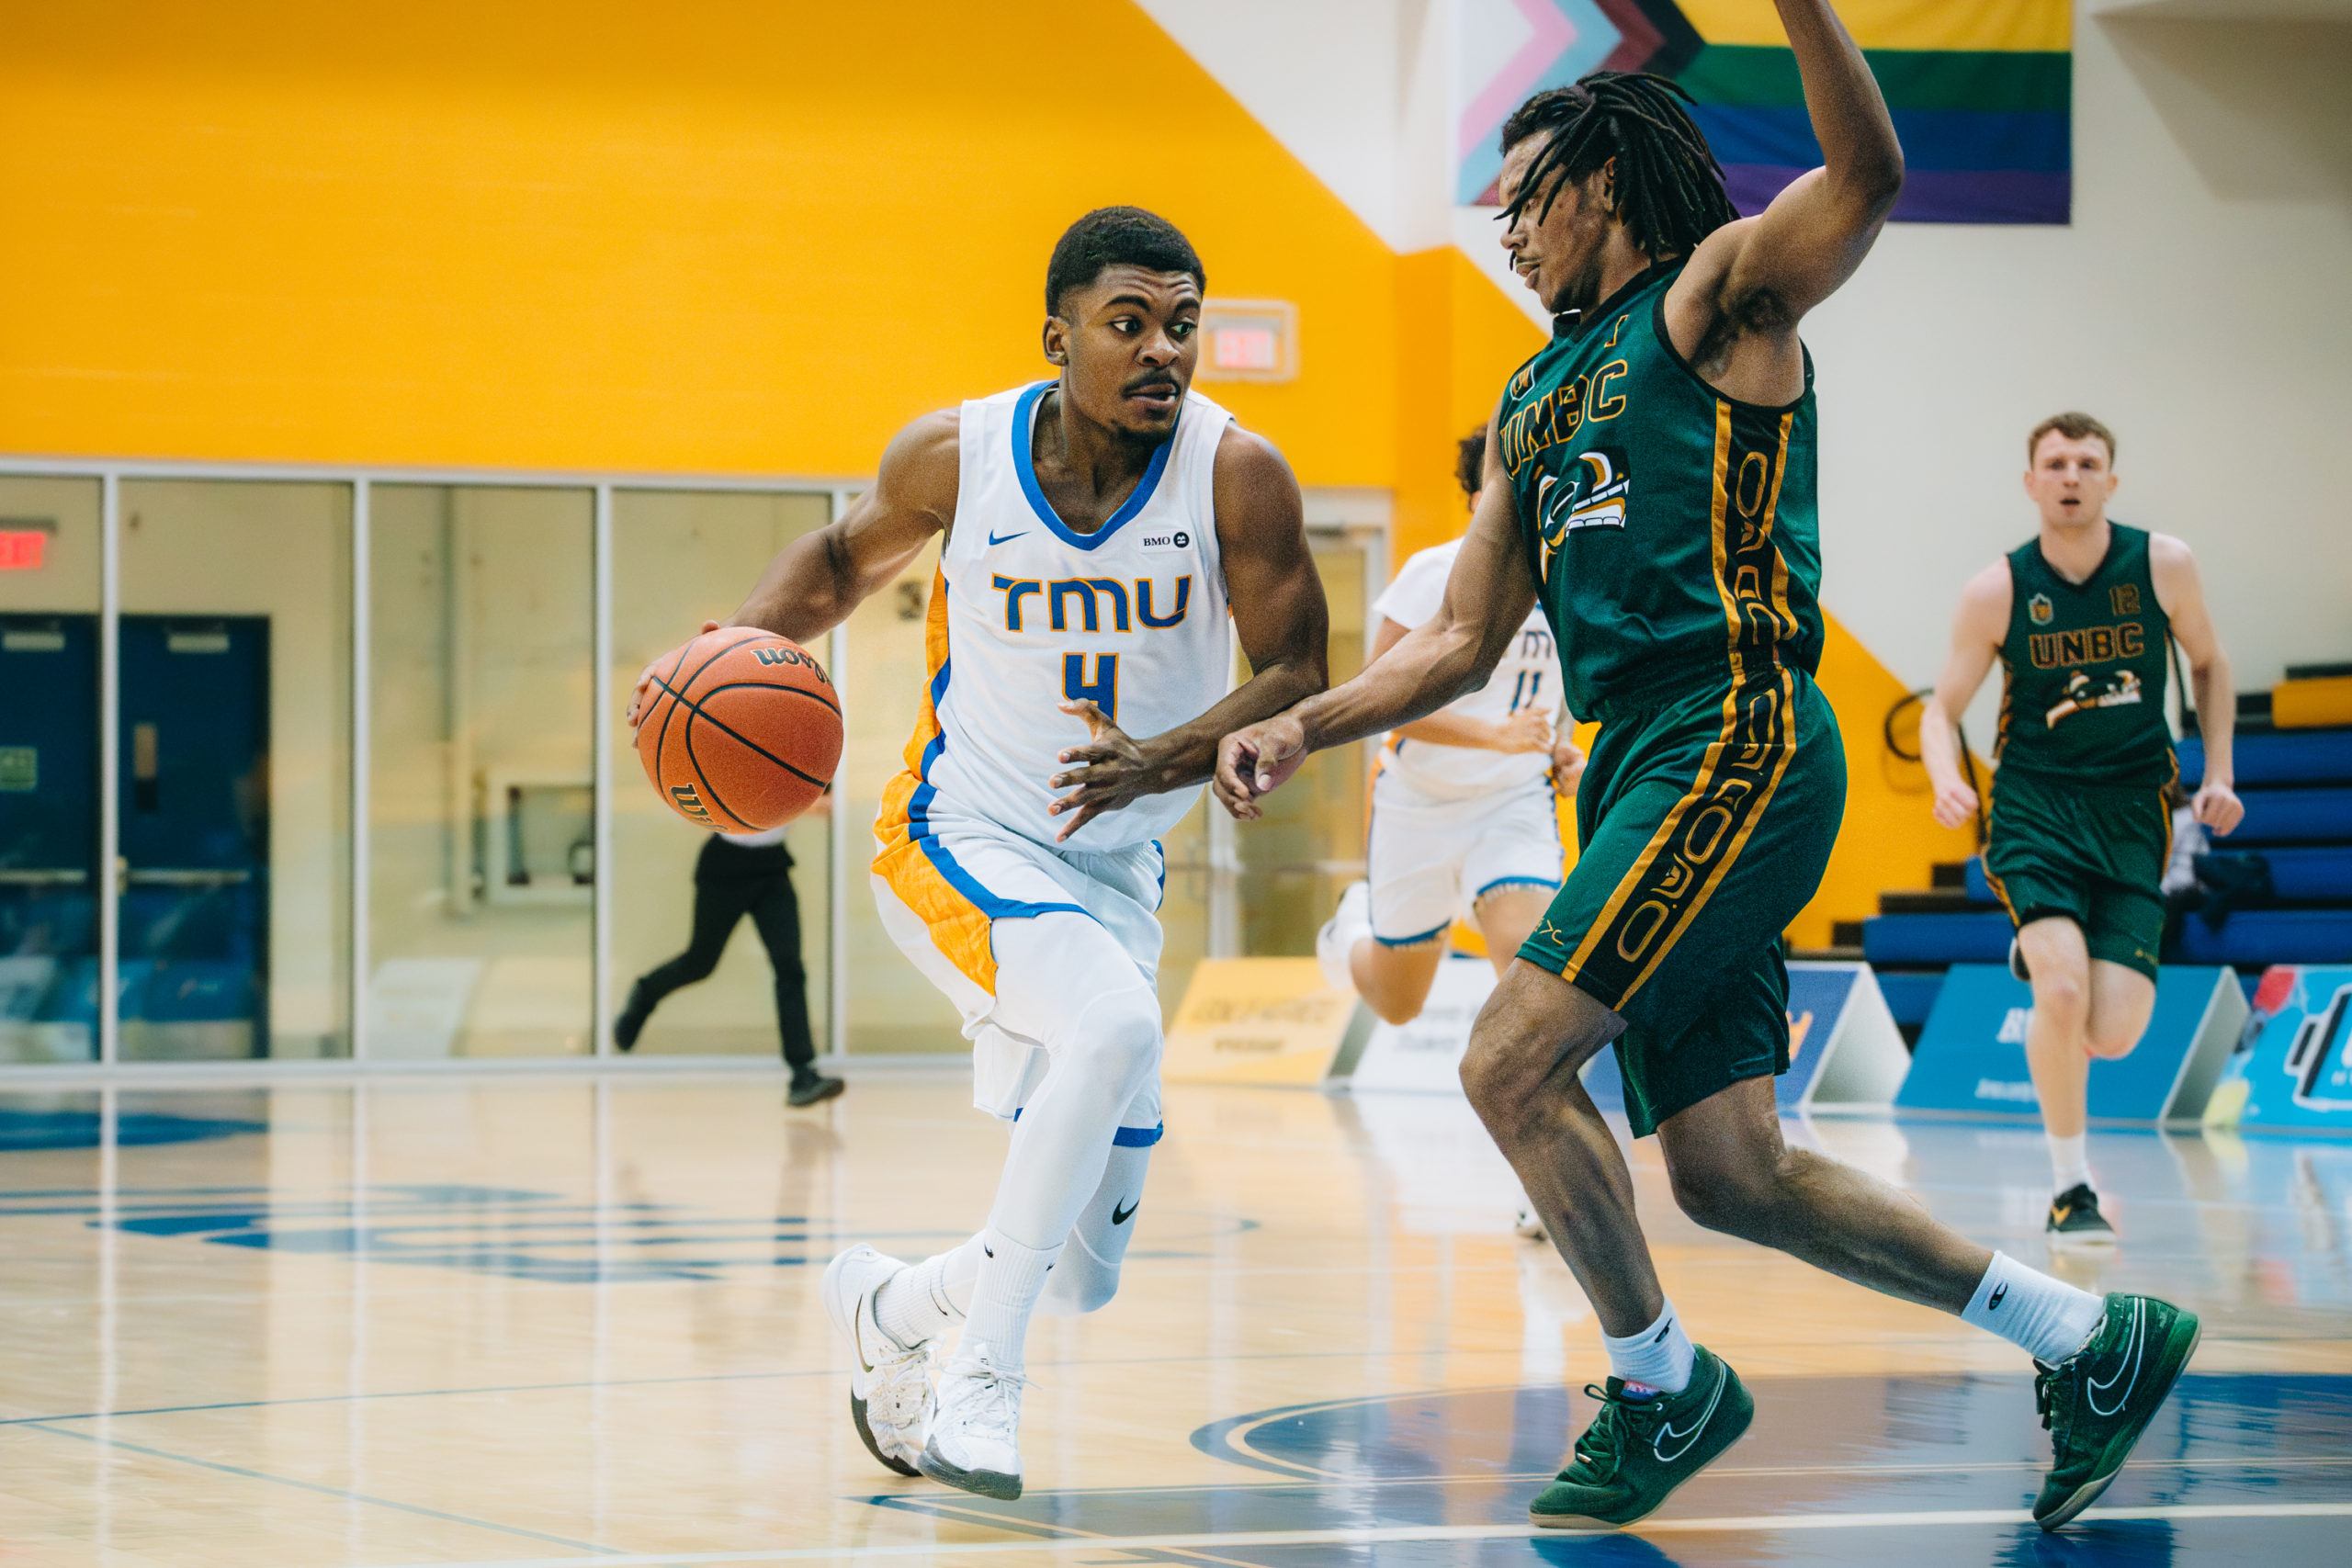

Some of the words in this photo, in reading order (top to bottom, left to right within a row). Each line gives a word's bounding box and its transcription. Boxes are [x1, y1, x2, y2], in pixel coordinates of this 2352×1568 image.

[1499, 358, 1629, 481] UNBC
[1143, 536, 1171, 547] BMO
[990, 571, 1193, 634] TMU
[2029, 622, 2145, 670] UNBC
[1061, 651, 1120, 725] 4
[1509, 669, 1542, 716] 11
